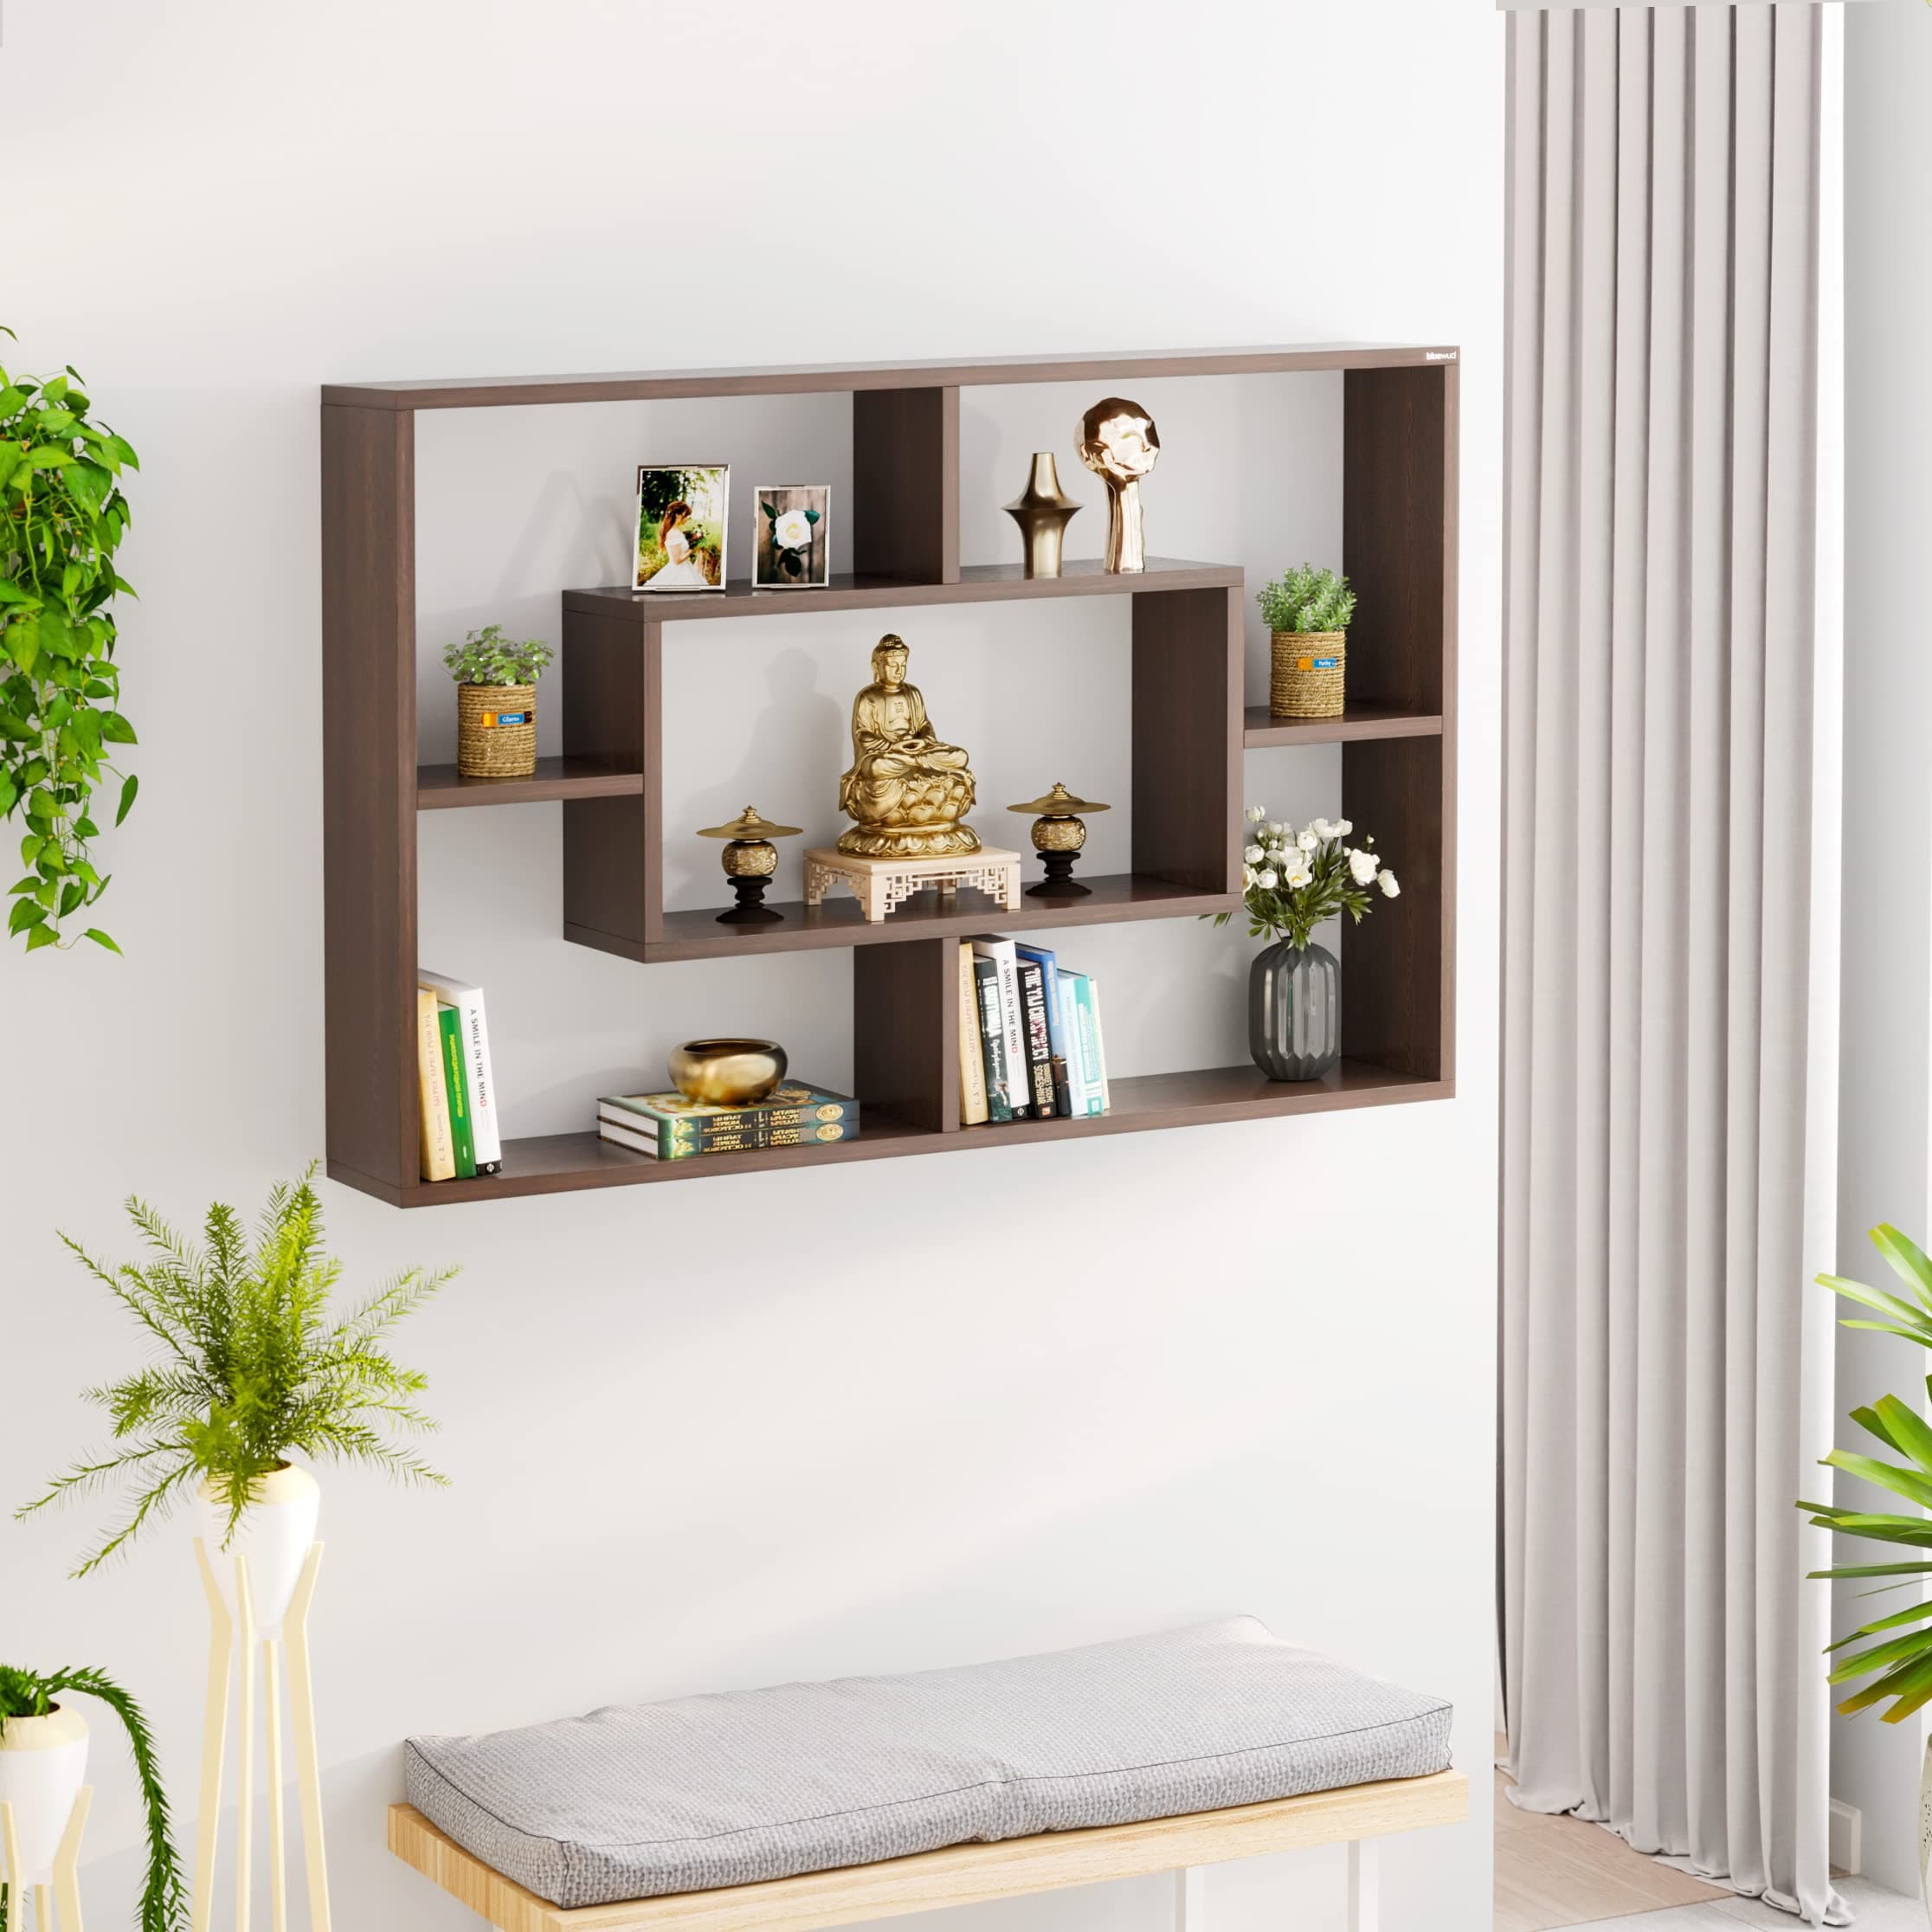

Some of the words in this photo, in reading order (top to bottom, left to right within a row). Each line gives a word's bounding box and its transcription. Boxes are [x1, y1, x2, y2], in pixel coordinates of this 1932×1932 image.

[1004, 969, 1013, 995] SMILE
[1025, 968, 1041, 988] THE
[1007, 998, 1014, 1007] IN
[1027, 988, 1044, 1007] TAJ
[471, 1018, 480, 1046] SMILE
[1028, 1006, 1049, 1060] CONSPIRACY
[474, 1049, 481, 1059] IN
[479, 1082, 487, 1107] MIND
